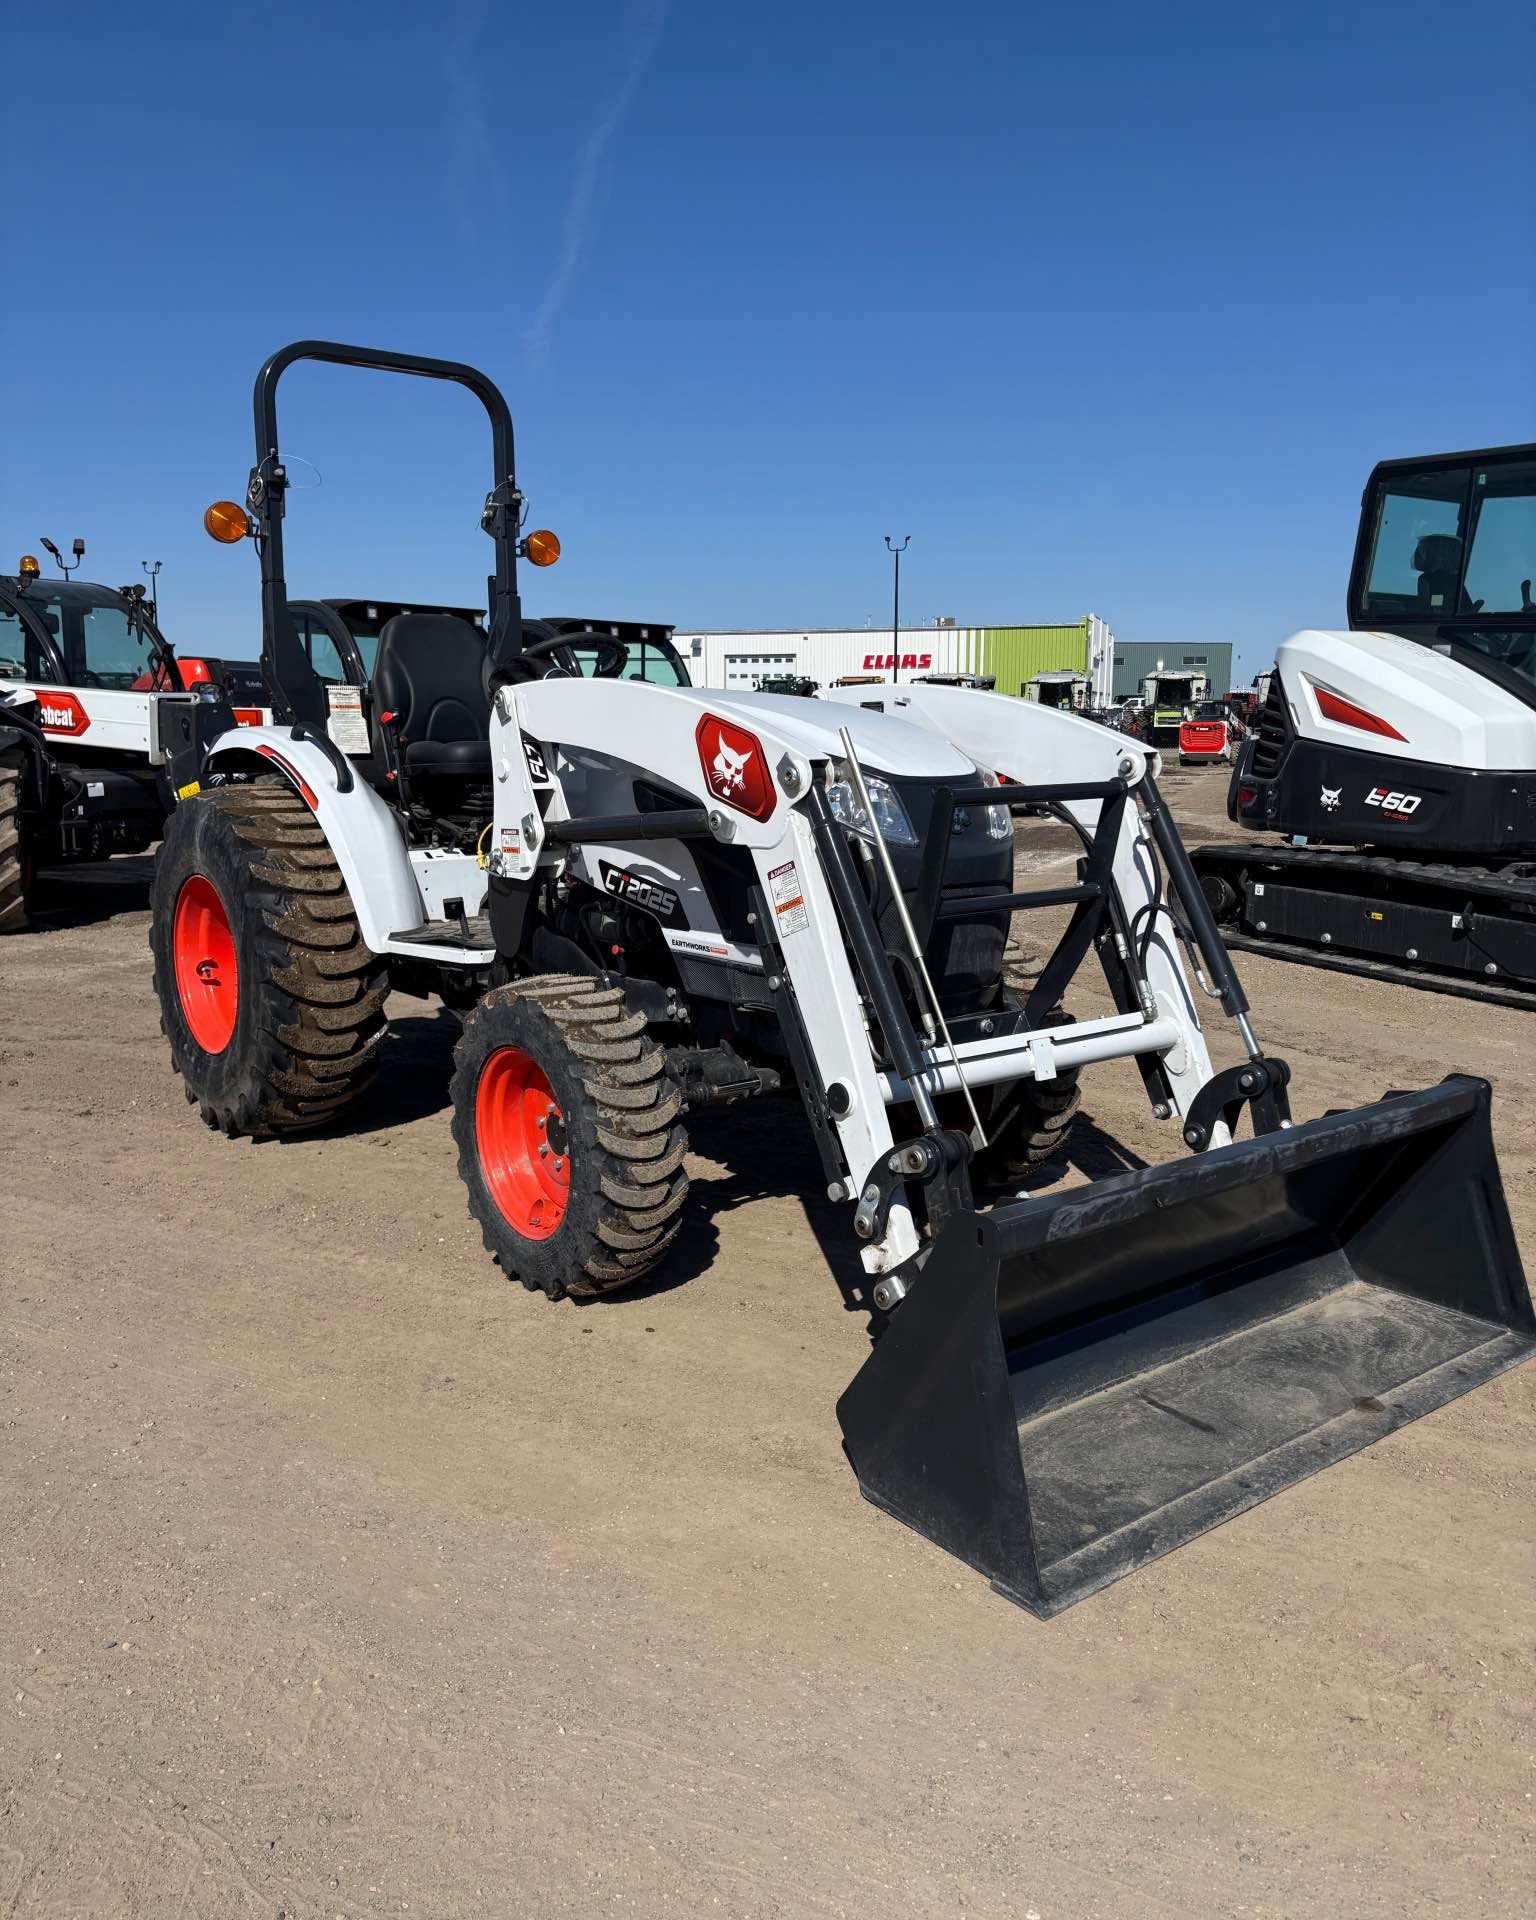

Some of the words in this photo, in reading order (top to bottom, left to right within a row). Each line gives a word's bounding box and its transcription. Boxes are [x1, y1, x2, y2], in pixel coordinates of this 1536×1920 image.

[863, 654, 932, 670] CLAAS
[41, 704, 73, 727] obcat
[523, 743, 547, 779] FL7
[1364, 787, 1422, 814] E60
[774, 863, 793, 876] DANGER
[671, 938, 711, 953] EARTHWORKS
